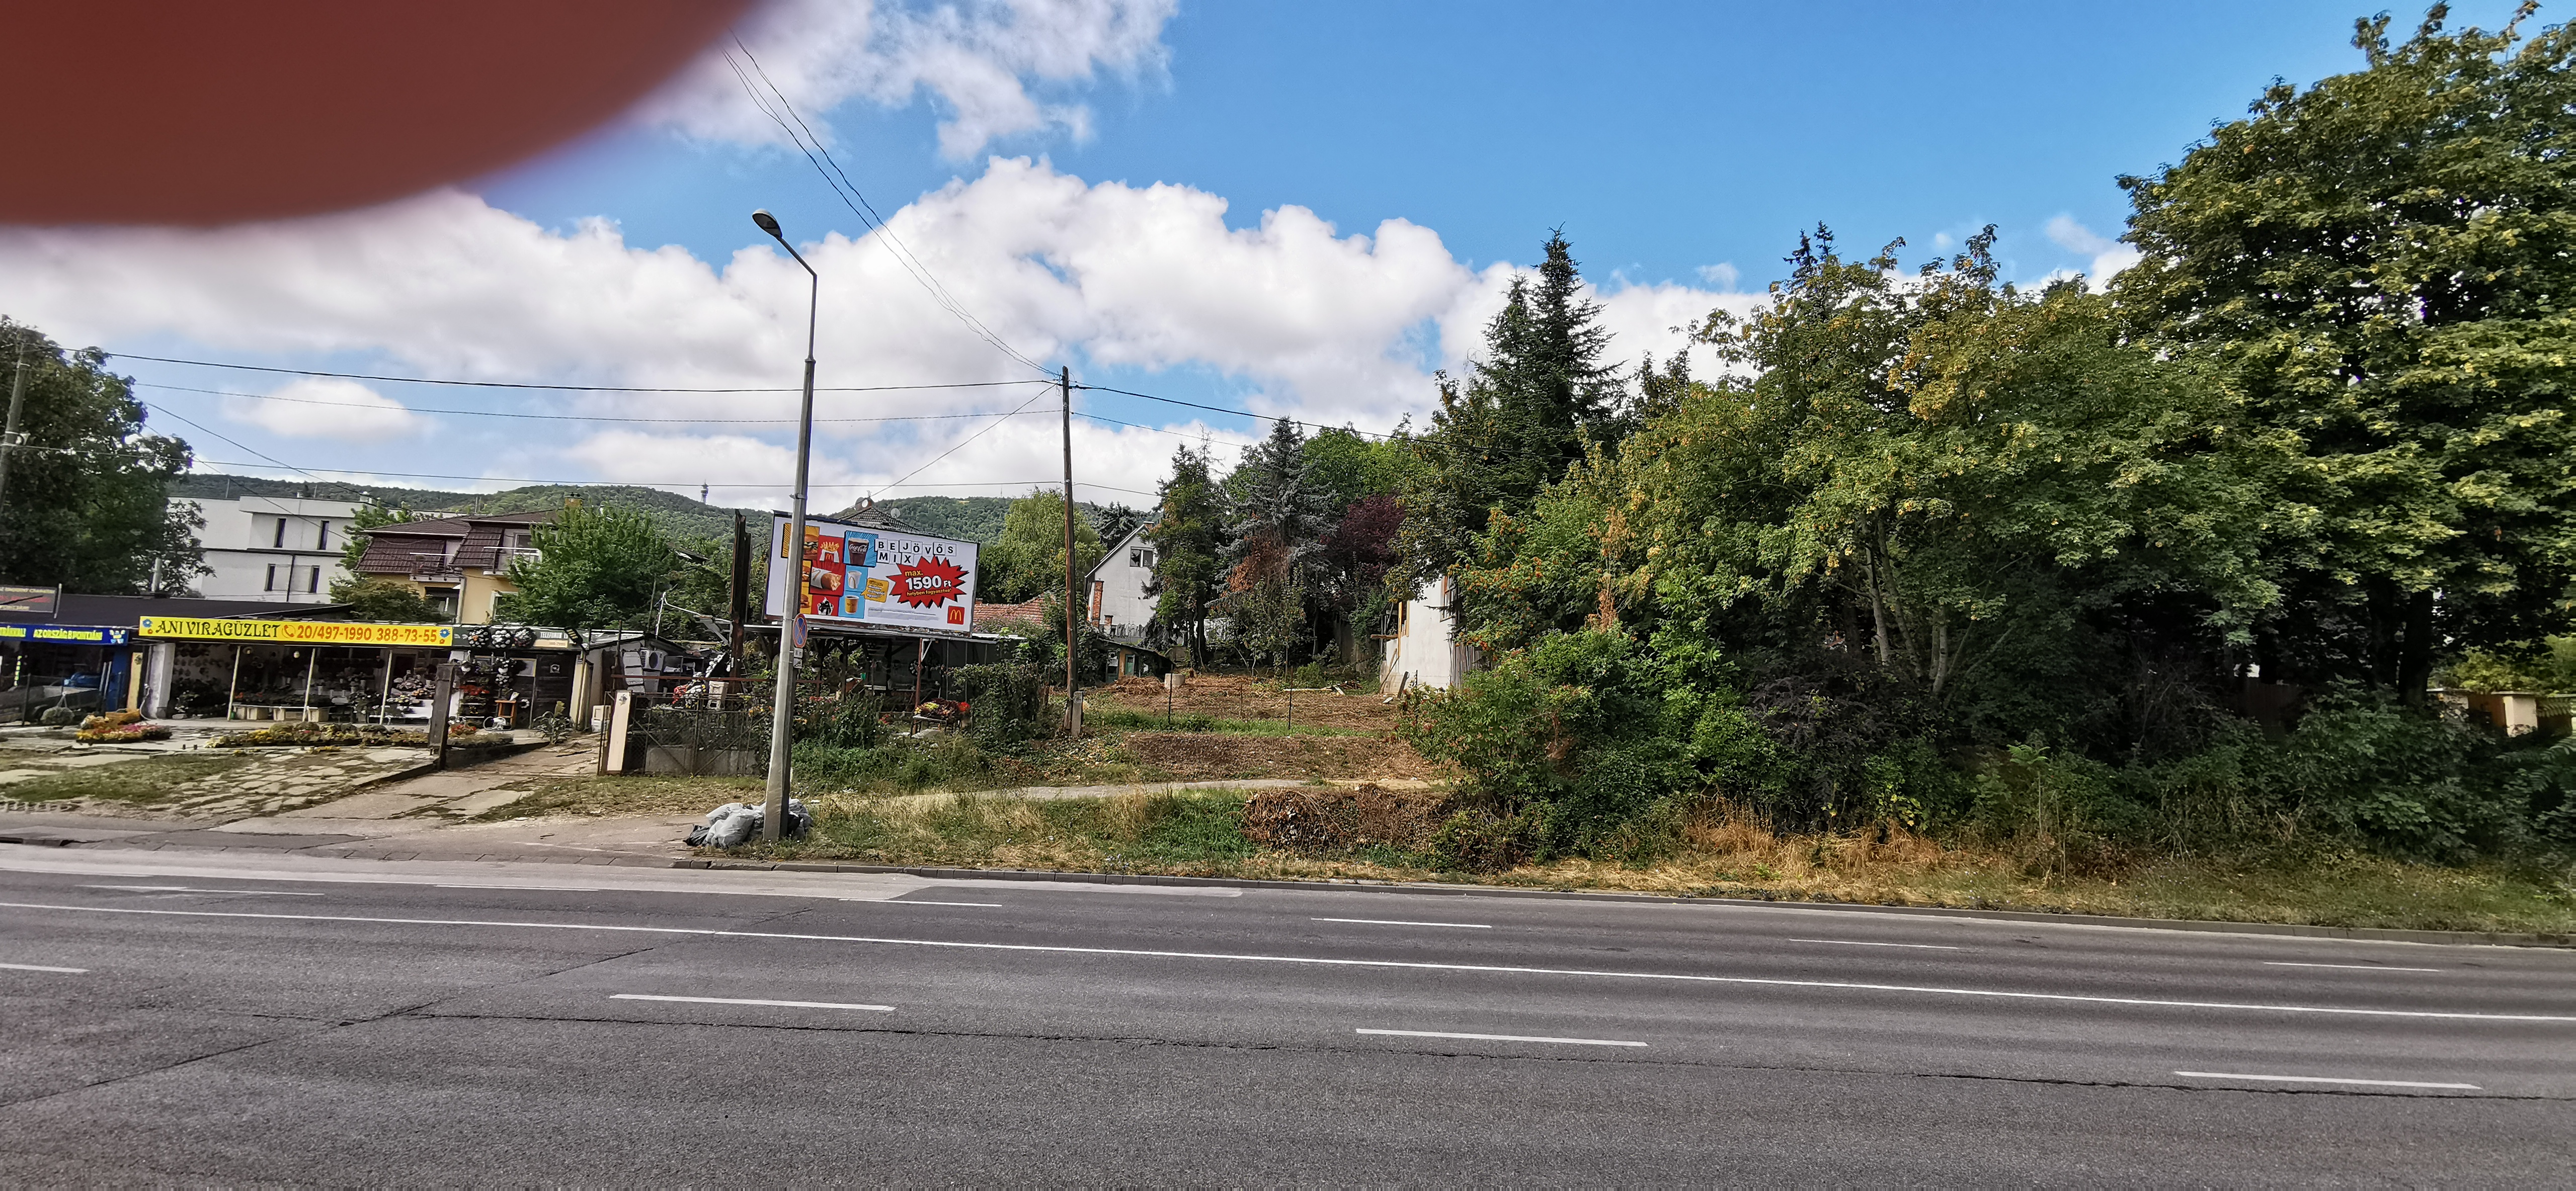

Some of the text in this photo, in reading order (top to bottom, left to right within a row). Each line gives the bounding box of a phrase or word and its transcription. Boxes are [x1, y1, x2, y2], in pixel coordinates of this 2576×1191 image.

[878, 541, 954, 554] BEJÖVŐS
[879, 553, 912, 563] MIX
[905, 575, 942, 590] 1590
[156, 620, 281, 637] ANI VIRÁGÜZLET
[377, 627, 437, 643] 388-73-55
